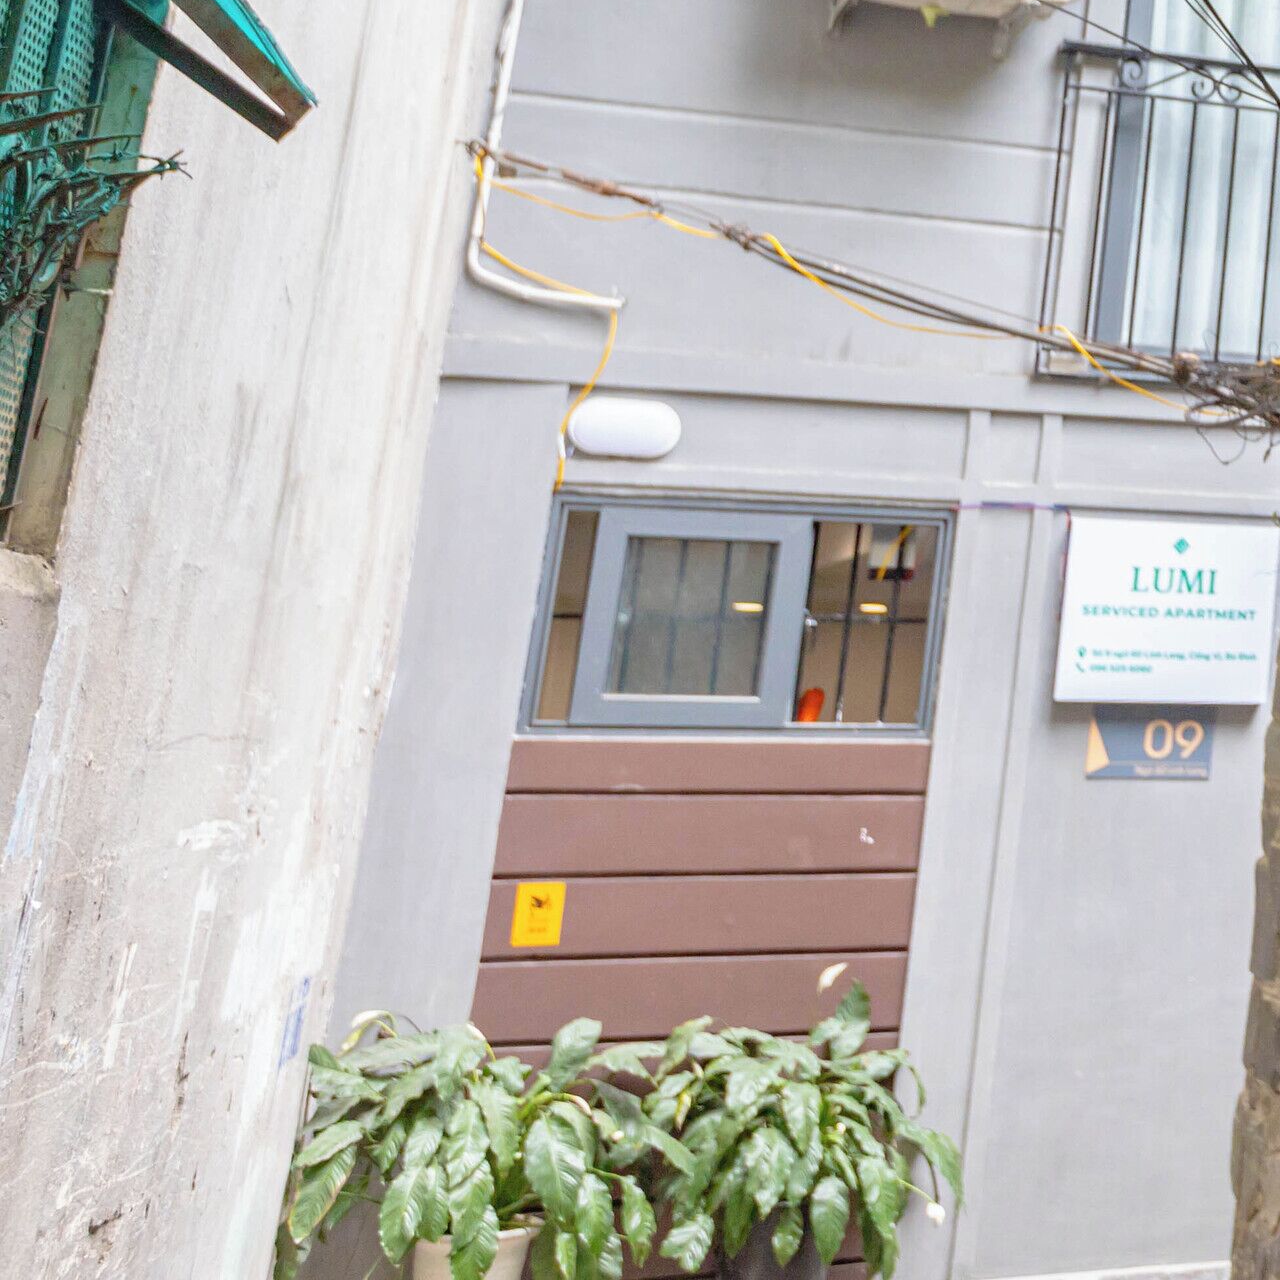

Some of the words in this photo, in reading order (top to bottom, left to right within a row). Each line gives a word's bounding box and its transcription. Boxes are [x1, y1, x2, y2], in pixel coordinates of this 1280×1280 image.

[1131, 566, 1218, 595] LUMI
[1082, 604, 1159, 619] SERVICED
[1164, 607, 1257, 621] APARTMENT
[1143, 719, 1205, 760] 09
